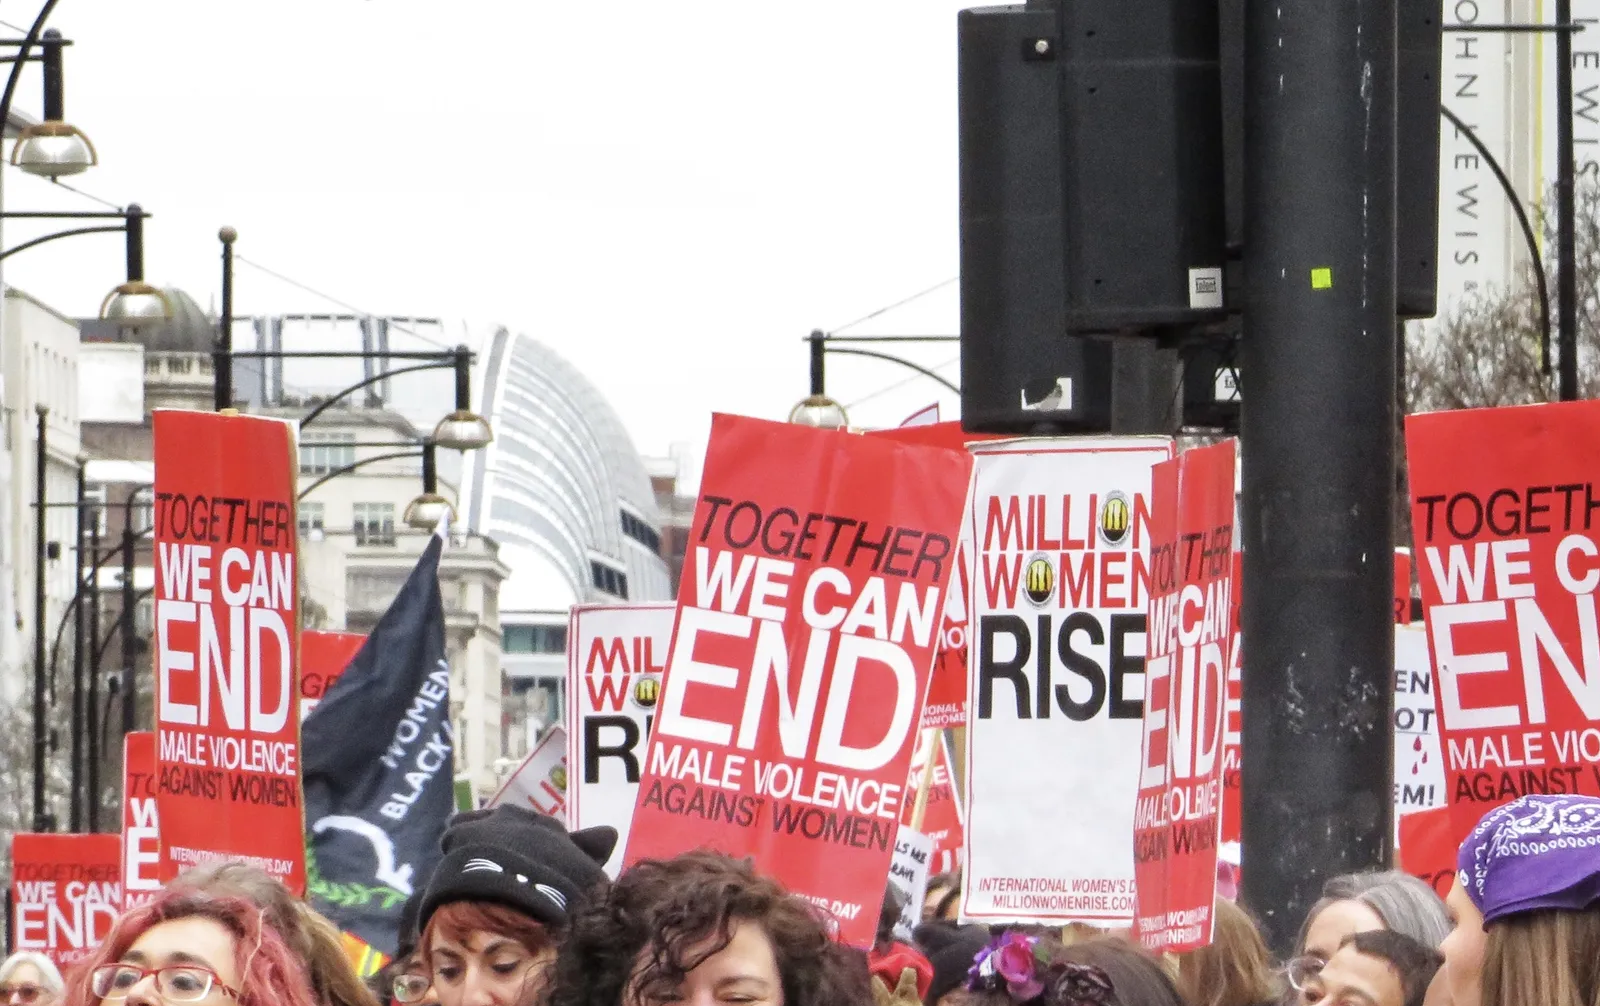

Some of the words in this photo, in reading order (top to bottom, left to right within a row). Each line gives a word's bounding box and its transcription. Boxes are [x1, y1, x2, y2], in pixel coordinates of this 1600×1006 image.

[1572, 18, 1600, 177] LEWIS
[1455, 124, 1479, 266] LEWIS
[156, 493, 290, 548] TOGETHER
[700, 495, 950, 581] TOGETHER
[159, 542, 212, 603] WE
[220, 547, 292, 611] CAN
[696, 547, 797, 622] WE
[803, 567, 939, 647] CAN
[1426, 540, 1534, 602] WE
[1150, 591, 1179, 657] WE
[1178, 577, 1229, 647] CAN
[157, 599, 291, 733] END
[657, 607, 917, 771] END
[978, 611, 1147, 722] RISE
[1140, 643, 1222, 789] END
[160, 730, 206, 767] MALE
[209, 736, 296, 776] VIOLENCE
[651, 742, 747, 793] MALE
[754, 758, 901, 819] VIOLENCE
[1449, 735, 1542, 770] MALE
[158, 765, 224, 799] AGAINST
[229, 775, 297, 808] WOMEN
[643, 779, 764, 828] AGAINST
[772, 800, 892, 851] WOMEN
[1135, 792, 1168, 829] MALE
[1456, 768, 1579, 803] AGAINST
[15, 863, 118, 881] TOGETHER
[17, 882, 56, 902] WE
[66, 881, 121, 903] CAN
[979, 876, 1067, 894] INTERNATIONAL
[1071, 876, 1127, 894] WOMEN'S
[992, 894, 1135, 912] MILLIONWOMENRISE.COM
[15, 903, 119, 949] END
